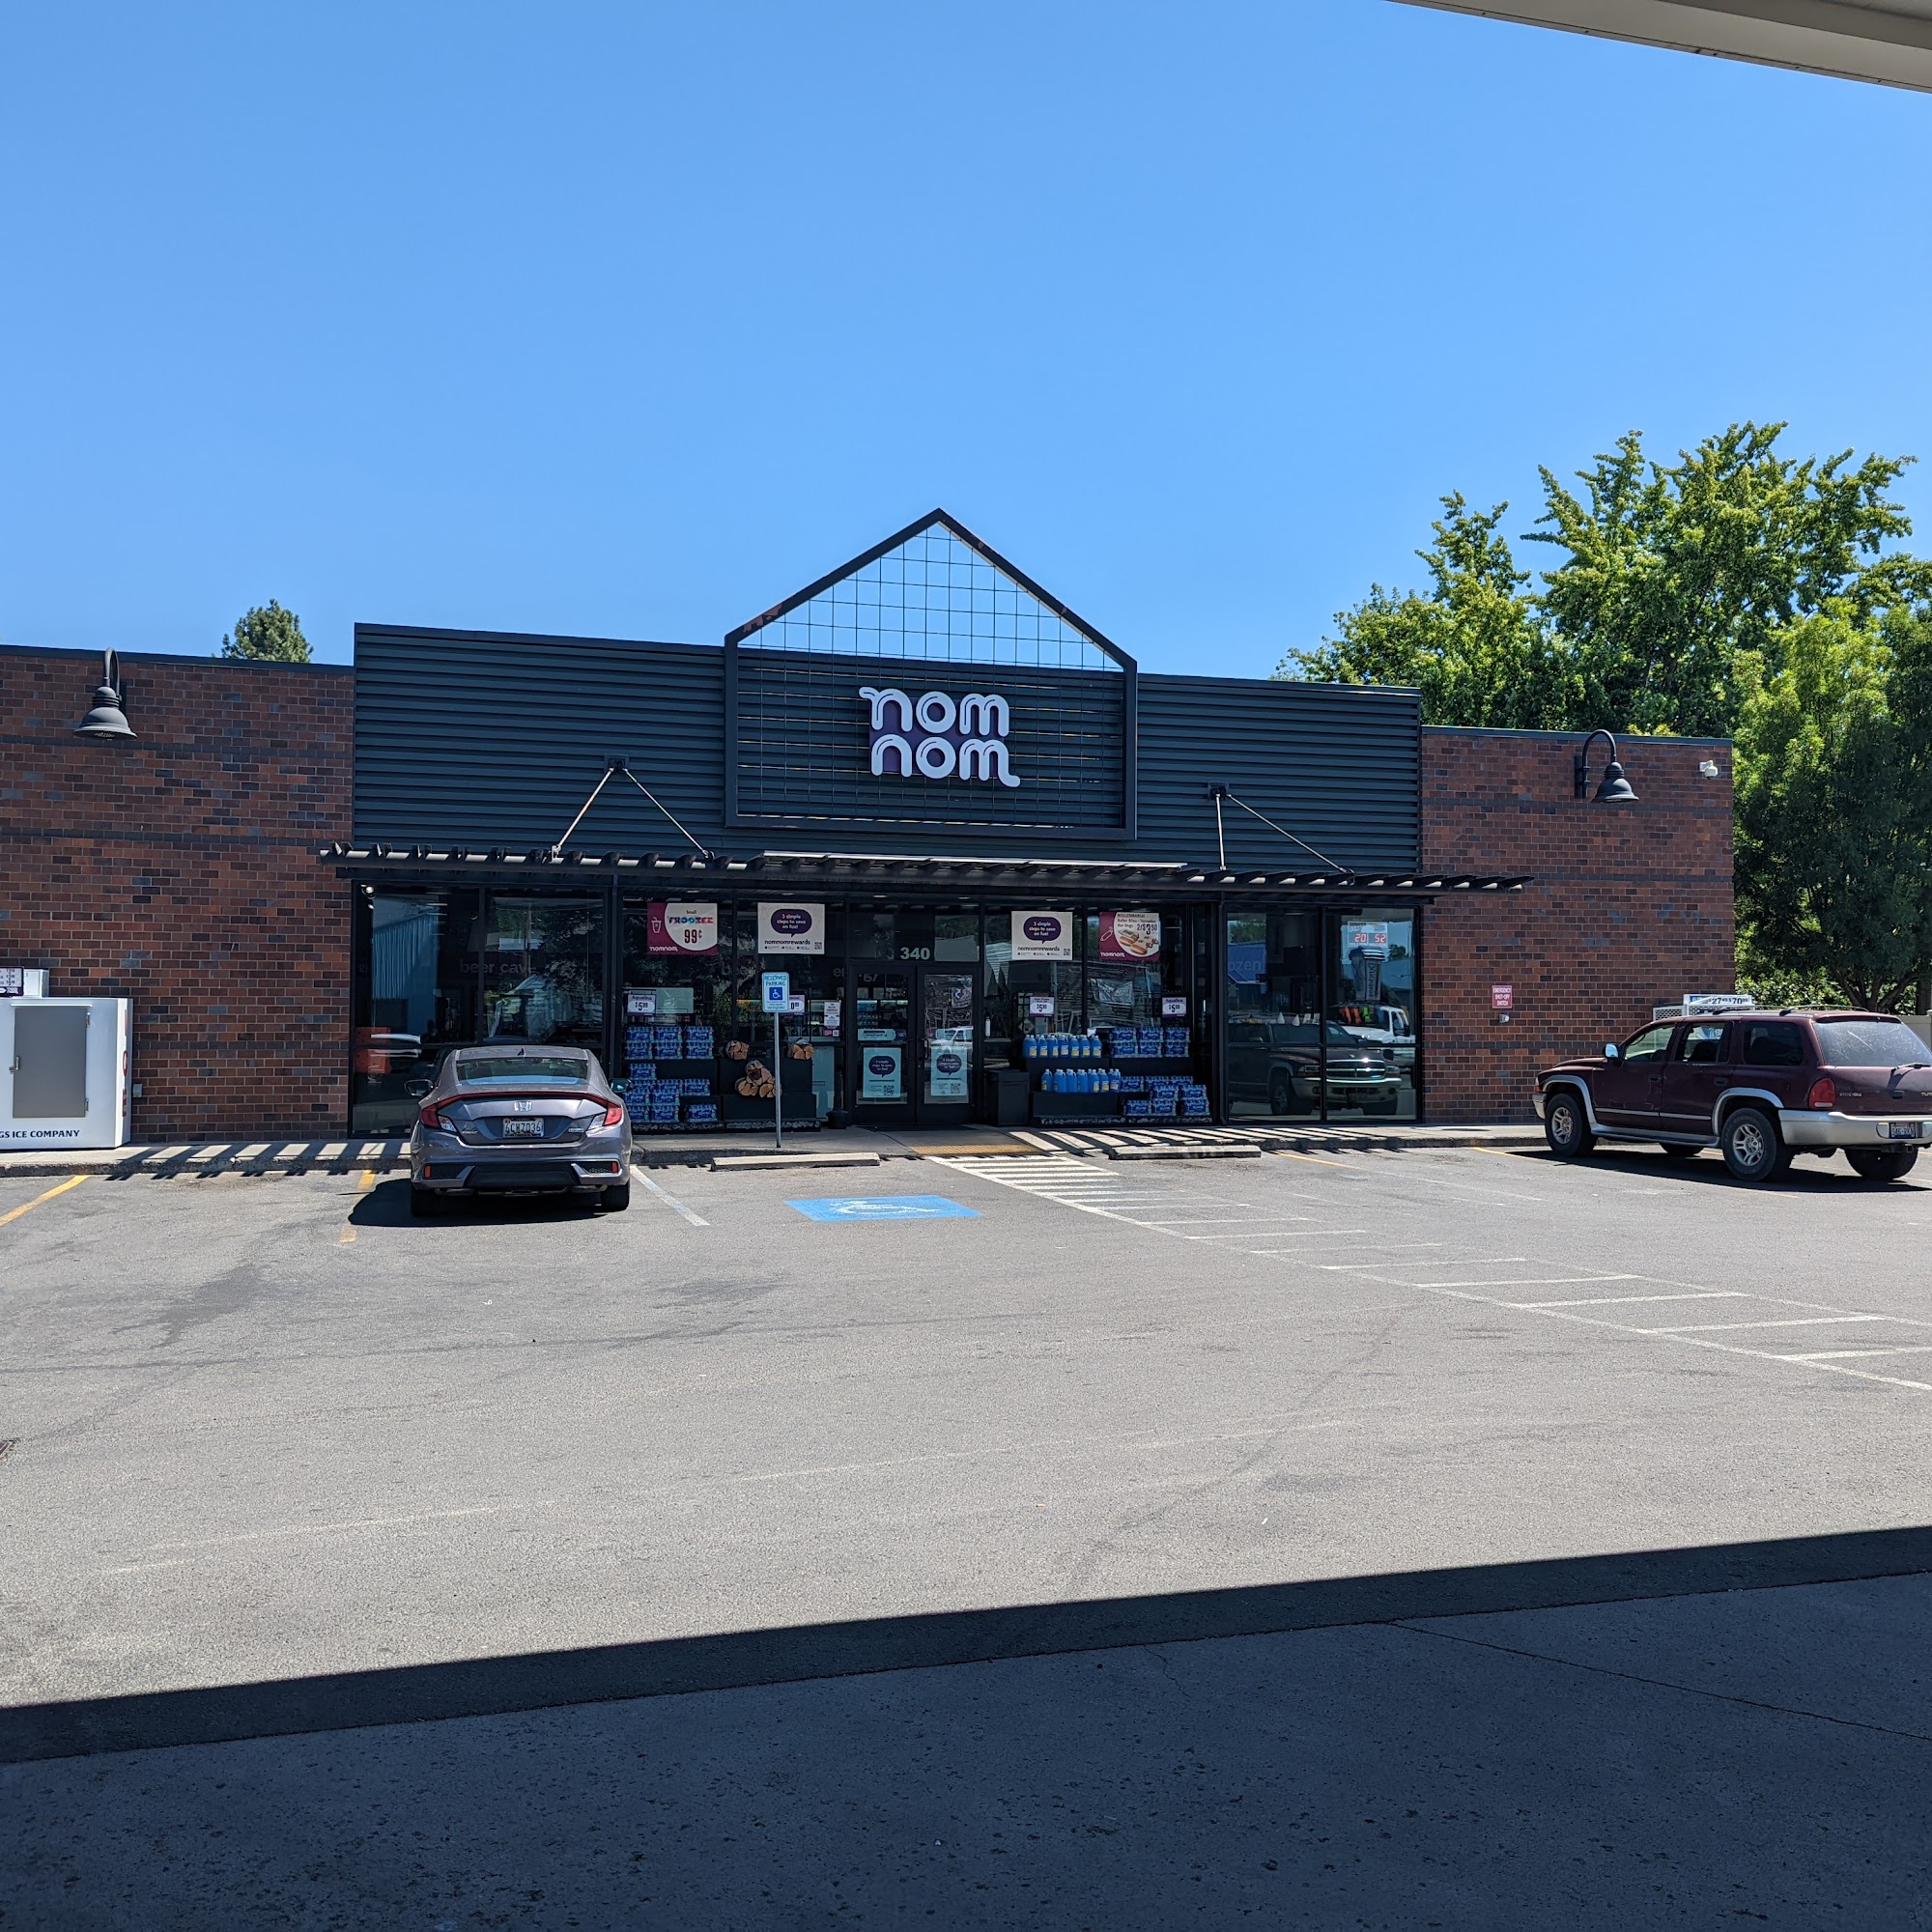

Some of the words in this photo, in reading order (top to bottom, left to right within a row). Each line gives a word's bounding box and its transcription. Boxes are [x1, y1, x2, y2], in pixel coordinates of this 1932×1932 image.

[859, 687, 1009, 737] nom
[870, 734, 1021, 787] nom
[900, 947, 930, 960] 340
[30, 1129, 80, 1138] COMPANY
